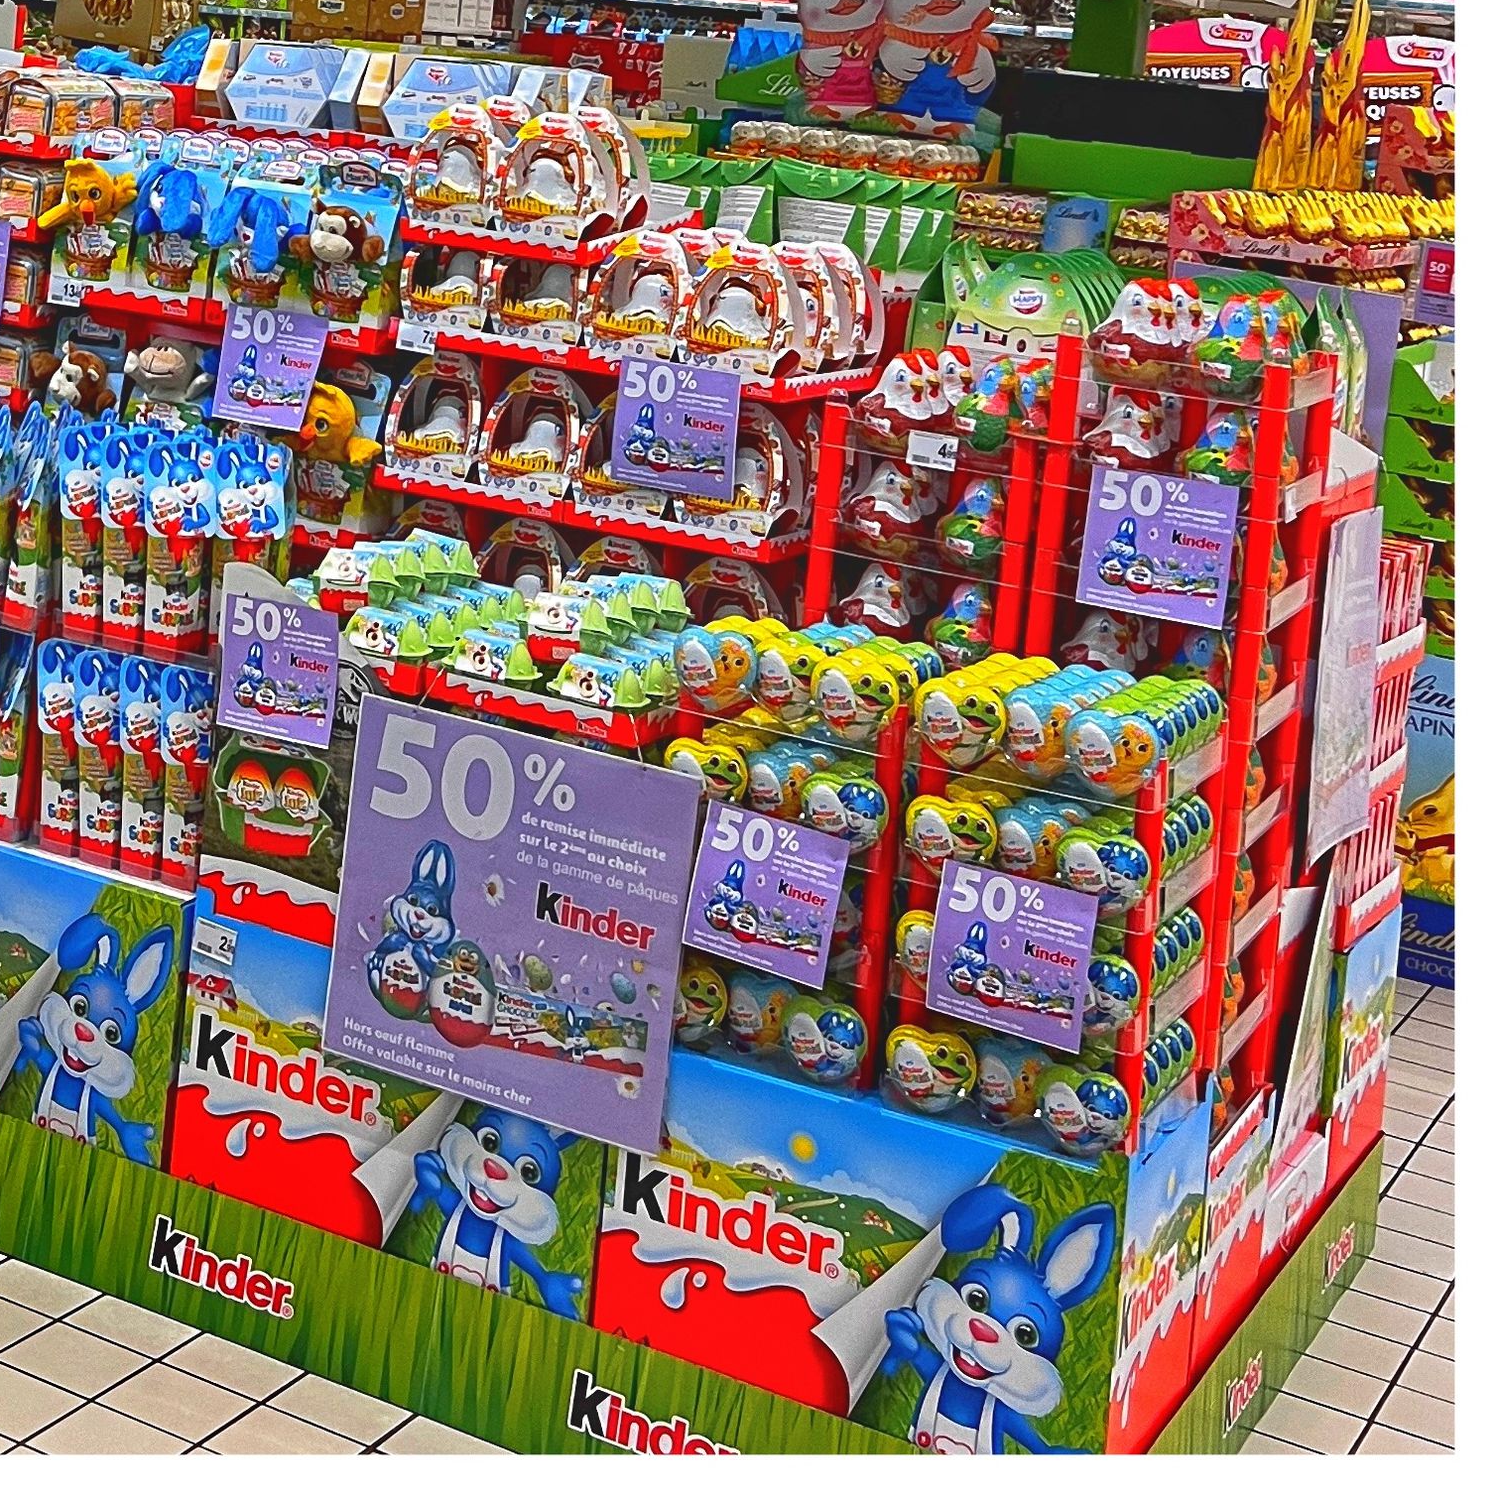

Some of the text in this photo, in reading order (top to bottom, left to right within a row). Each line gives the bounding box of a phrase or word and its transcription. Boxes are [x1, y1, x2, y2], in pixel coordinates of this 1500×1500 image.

[1151, 66, 1230, 80] JOYEUSES
[1364, 86, 1421, 100] EUSES
[230, 307, 294, 344] 50%
[279, 354, 312, 371] Kinder
[623, 362, 698, 402] 50%
[683, 412, 726, 433] Kinder
[1100, 471, 1189, 517] 50%
[1171, 529, 1222, 552] Kinder
[232, 597, 301, 641] 50%
[289, 652, 330, 674] Kinder
[1405, 716, 1455, 737] APIN
[370, 713, 576, 841] 50%
[520, 832, 542, 848] sur
[545, 836, 558, 852] le
[608, 855, 648, 877] choix
[521, 811, 667, 861] de remise immédiate
[711, 807, 800, 862] 50%
[517, 850, 678, 905] de la gamme de pâques
[778, 878, 828, 907] Kinder
[948, 865, 1045, 923] 50%
[536, 882, 656, 950] Kinder
[1024, 939, 1078, 969] Kinder
[344, 1015, 371, 1032] Hors
[196, 1012, 377, 1126] Kinder
[342, 1034, 532, 1106] Offre valable sur le moins cher
[623, 1154, 839, 1277] Kinder
[1207, 1183, 1247, 1255] Kinder
[151, 1215, 295, 1318] Kinder
[1118, 1255, 1175, 1359] Kinder
